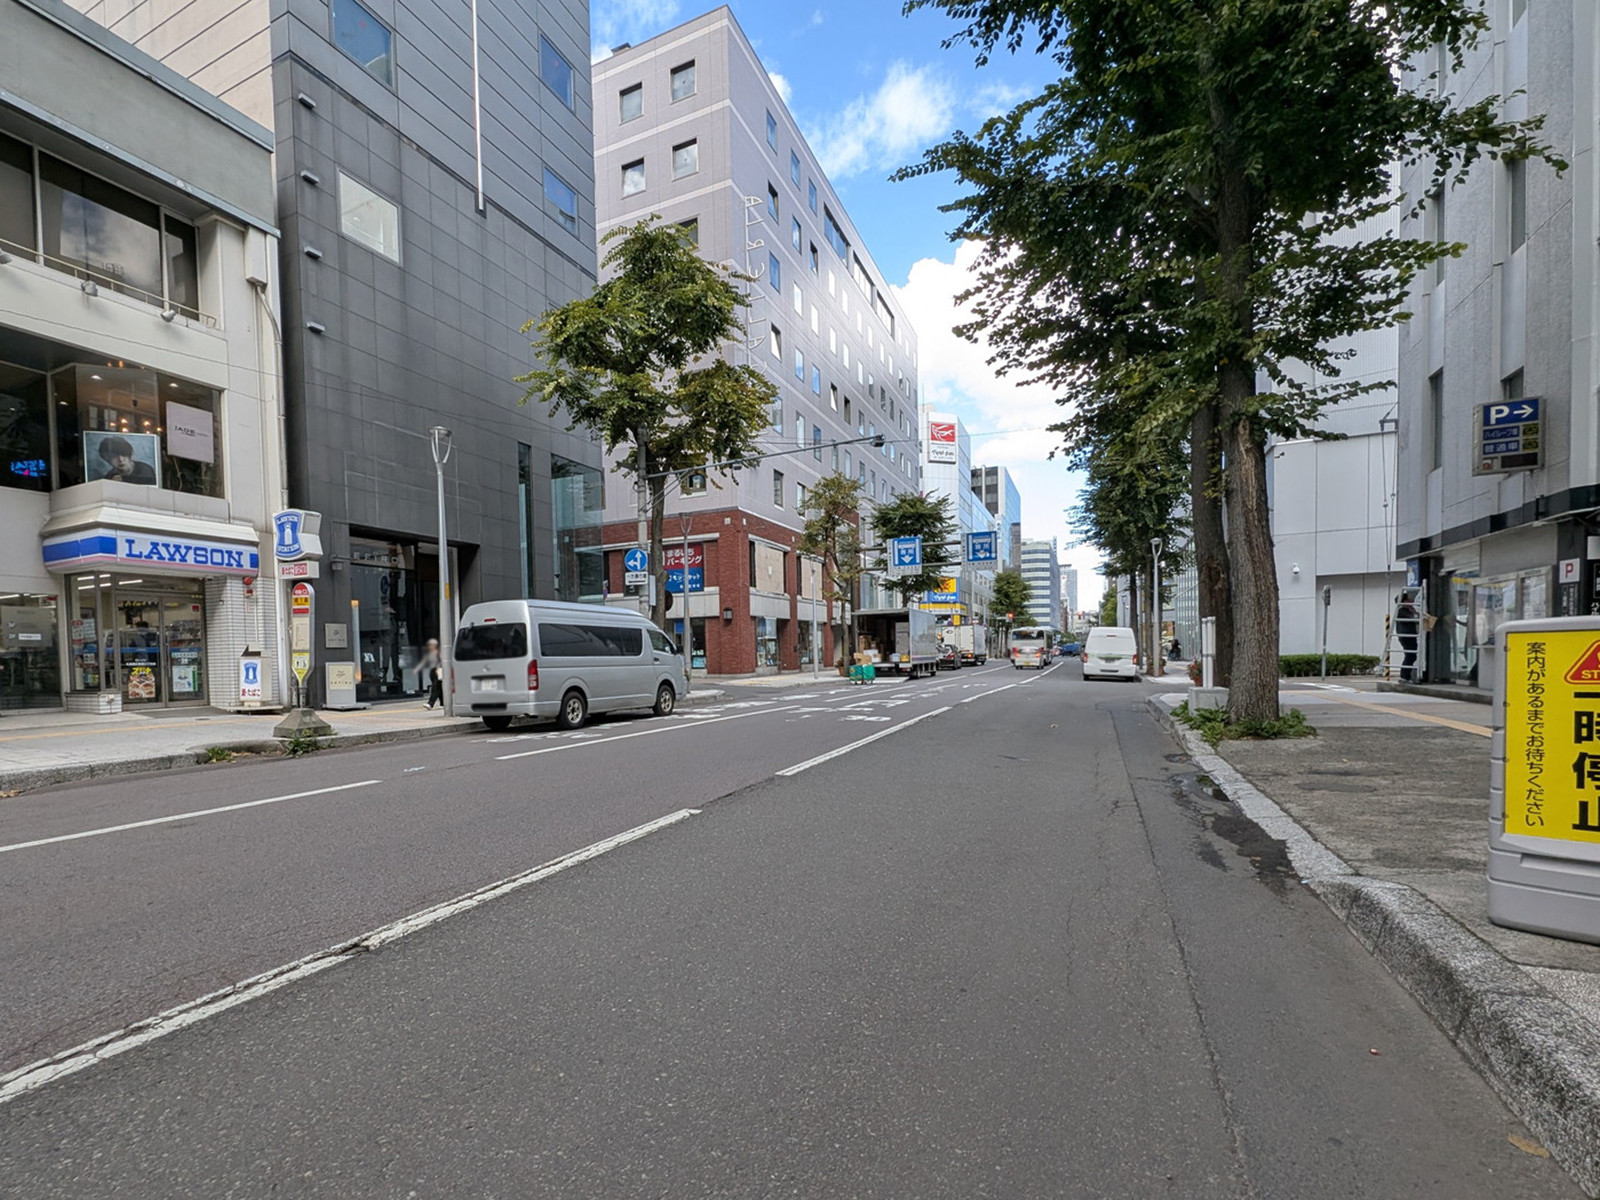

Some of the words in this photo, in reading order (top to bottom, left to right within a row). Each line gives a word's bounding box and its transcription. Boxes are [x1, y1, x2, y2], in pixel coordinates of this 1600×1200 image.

[1490, 405, 1510, 425] P
[1485, 442, 1518, 453] 普通車
[125, 539, 243, 568] LAWSON
[1565, 562, 1573, 579] P
[1525, 641, 1546, 827] 案内があるまでお待ちください
